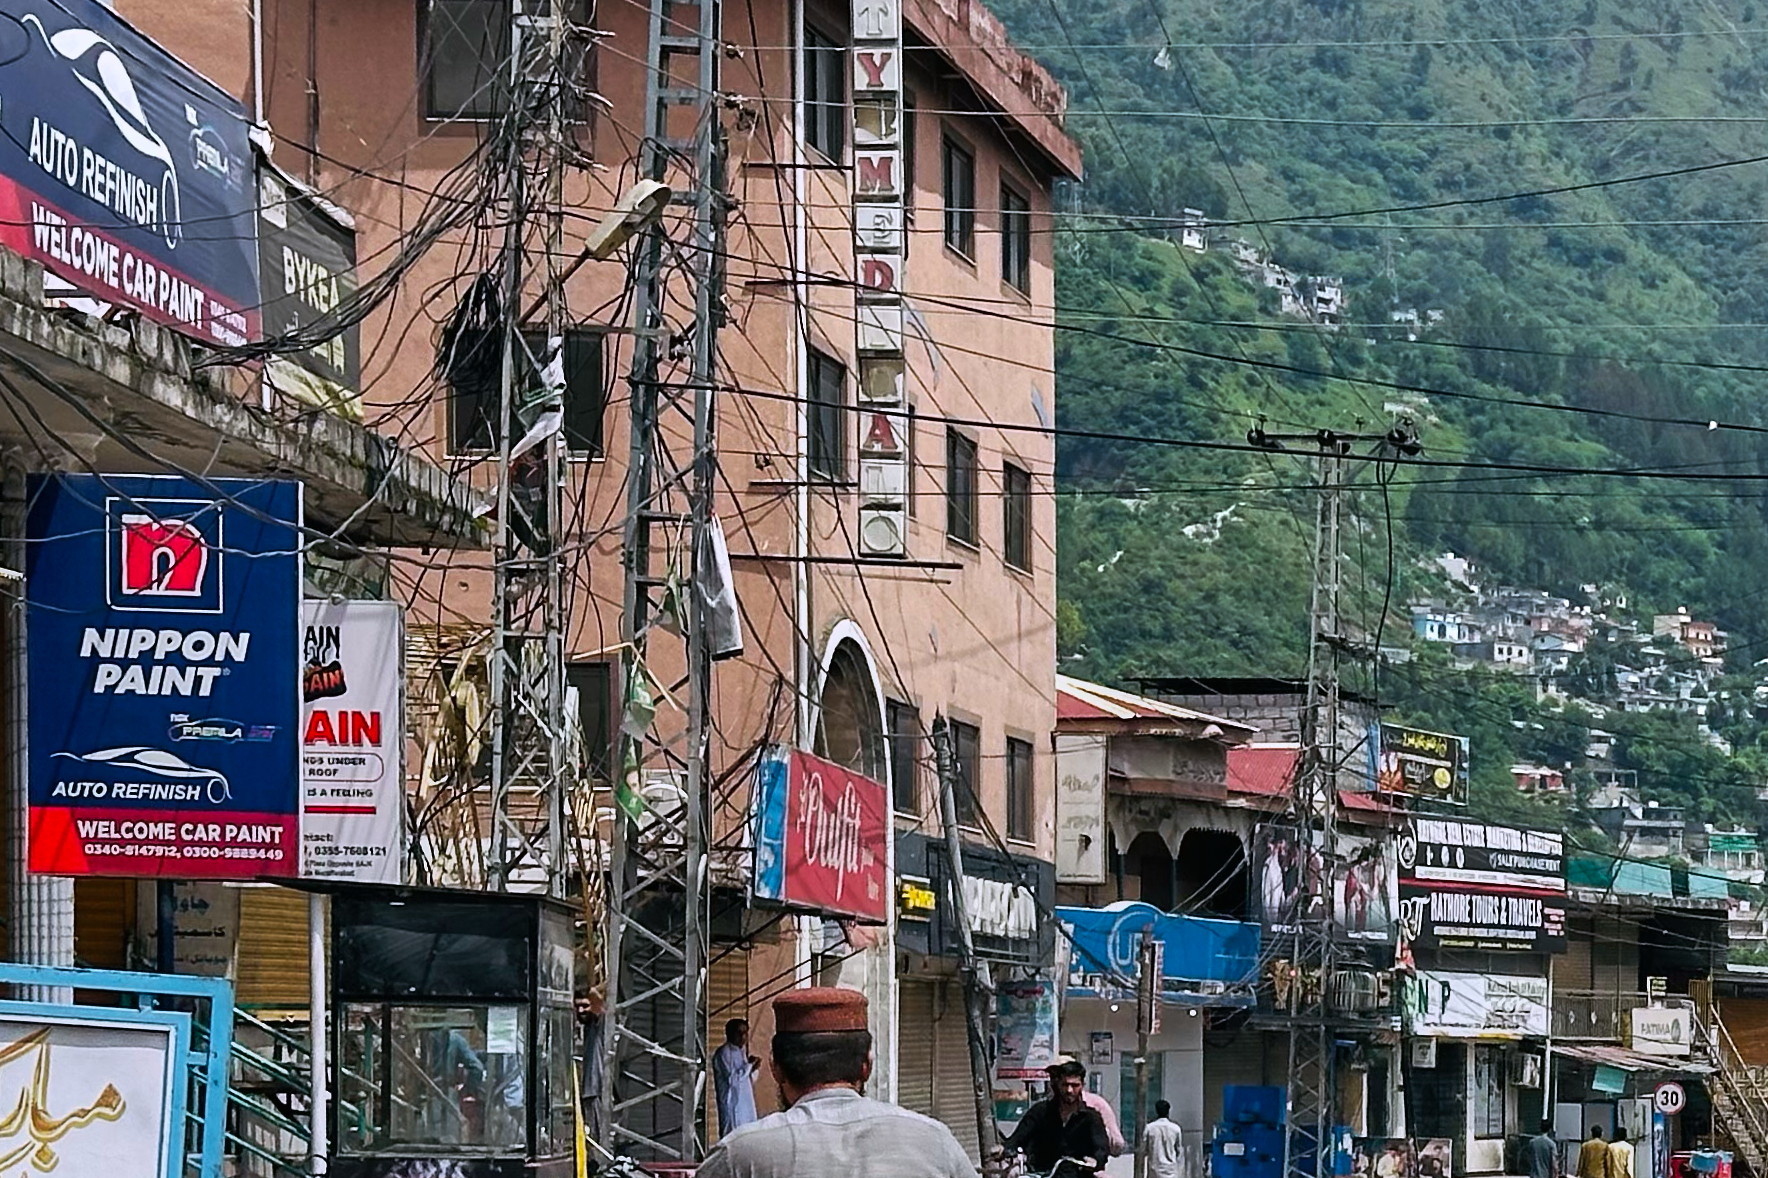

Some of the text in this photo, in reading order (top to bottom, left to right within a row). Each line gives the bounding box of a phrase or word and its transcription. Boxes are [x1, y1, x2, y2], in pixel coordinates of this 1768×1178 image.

[29, 117, 78, 187] AUTO
[82, 146, 158, 232] REFINISH
[32, 201, 119, 288] WELCOME
[122, 252, 156, 307] CAR
[159, 270, 205, 329] PAINT
[283, 246, 340, 315] BYKEA
[80, 627, 250, 662] NIPPON
[93, 664, 221, 697] PAINT
[304, 668, 343, 694] AIN
[309, 768, 339, 776] ROOF
[327, 757, 366, 765] UNDER
[52, 781, 201, 800] AUTO REFINISH
[330, 788, 373, 797] FEELING
[77, 820, 284, 844] WELCOME CAR PAINT
[1430, 892, 1471, 923] RATHORE
[1472, 895, 1499, 925] TOURS
[1500, 896, 1507, 925] &
[1508, 897, 1543, 927] TRAVELS
[1418, 979, 1451, 1015] NP
[1641, 1023, 1670, 1035] FATIMA
[1661, 1090, 1680, 1107] 30
